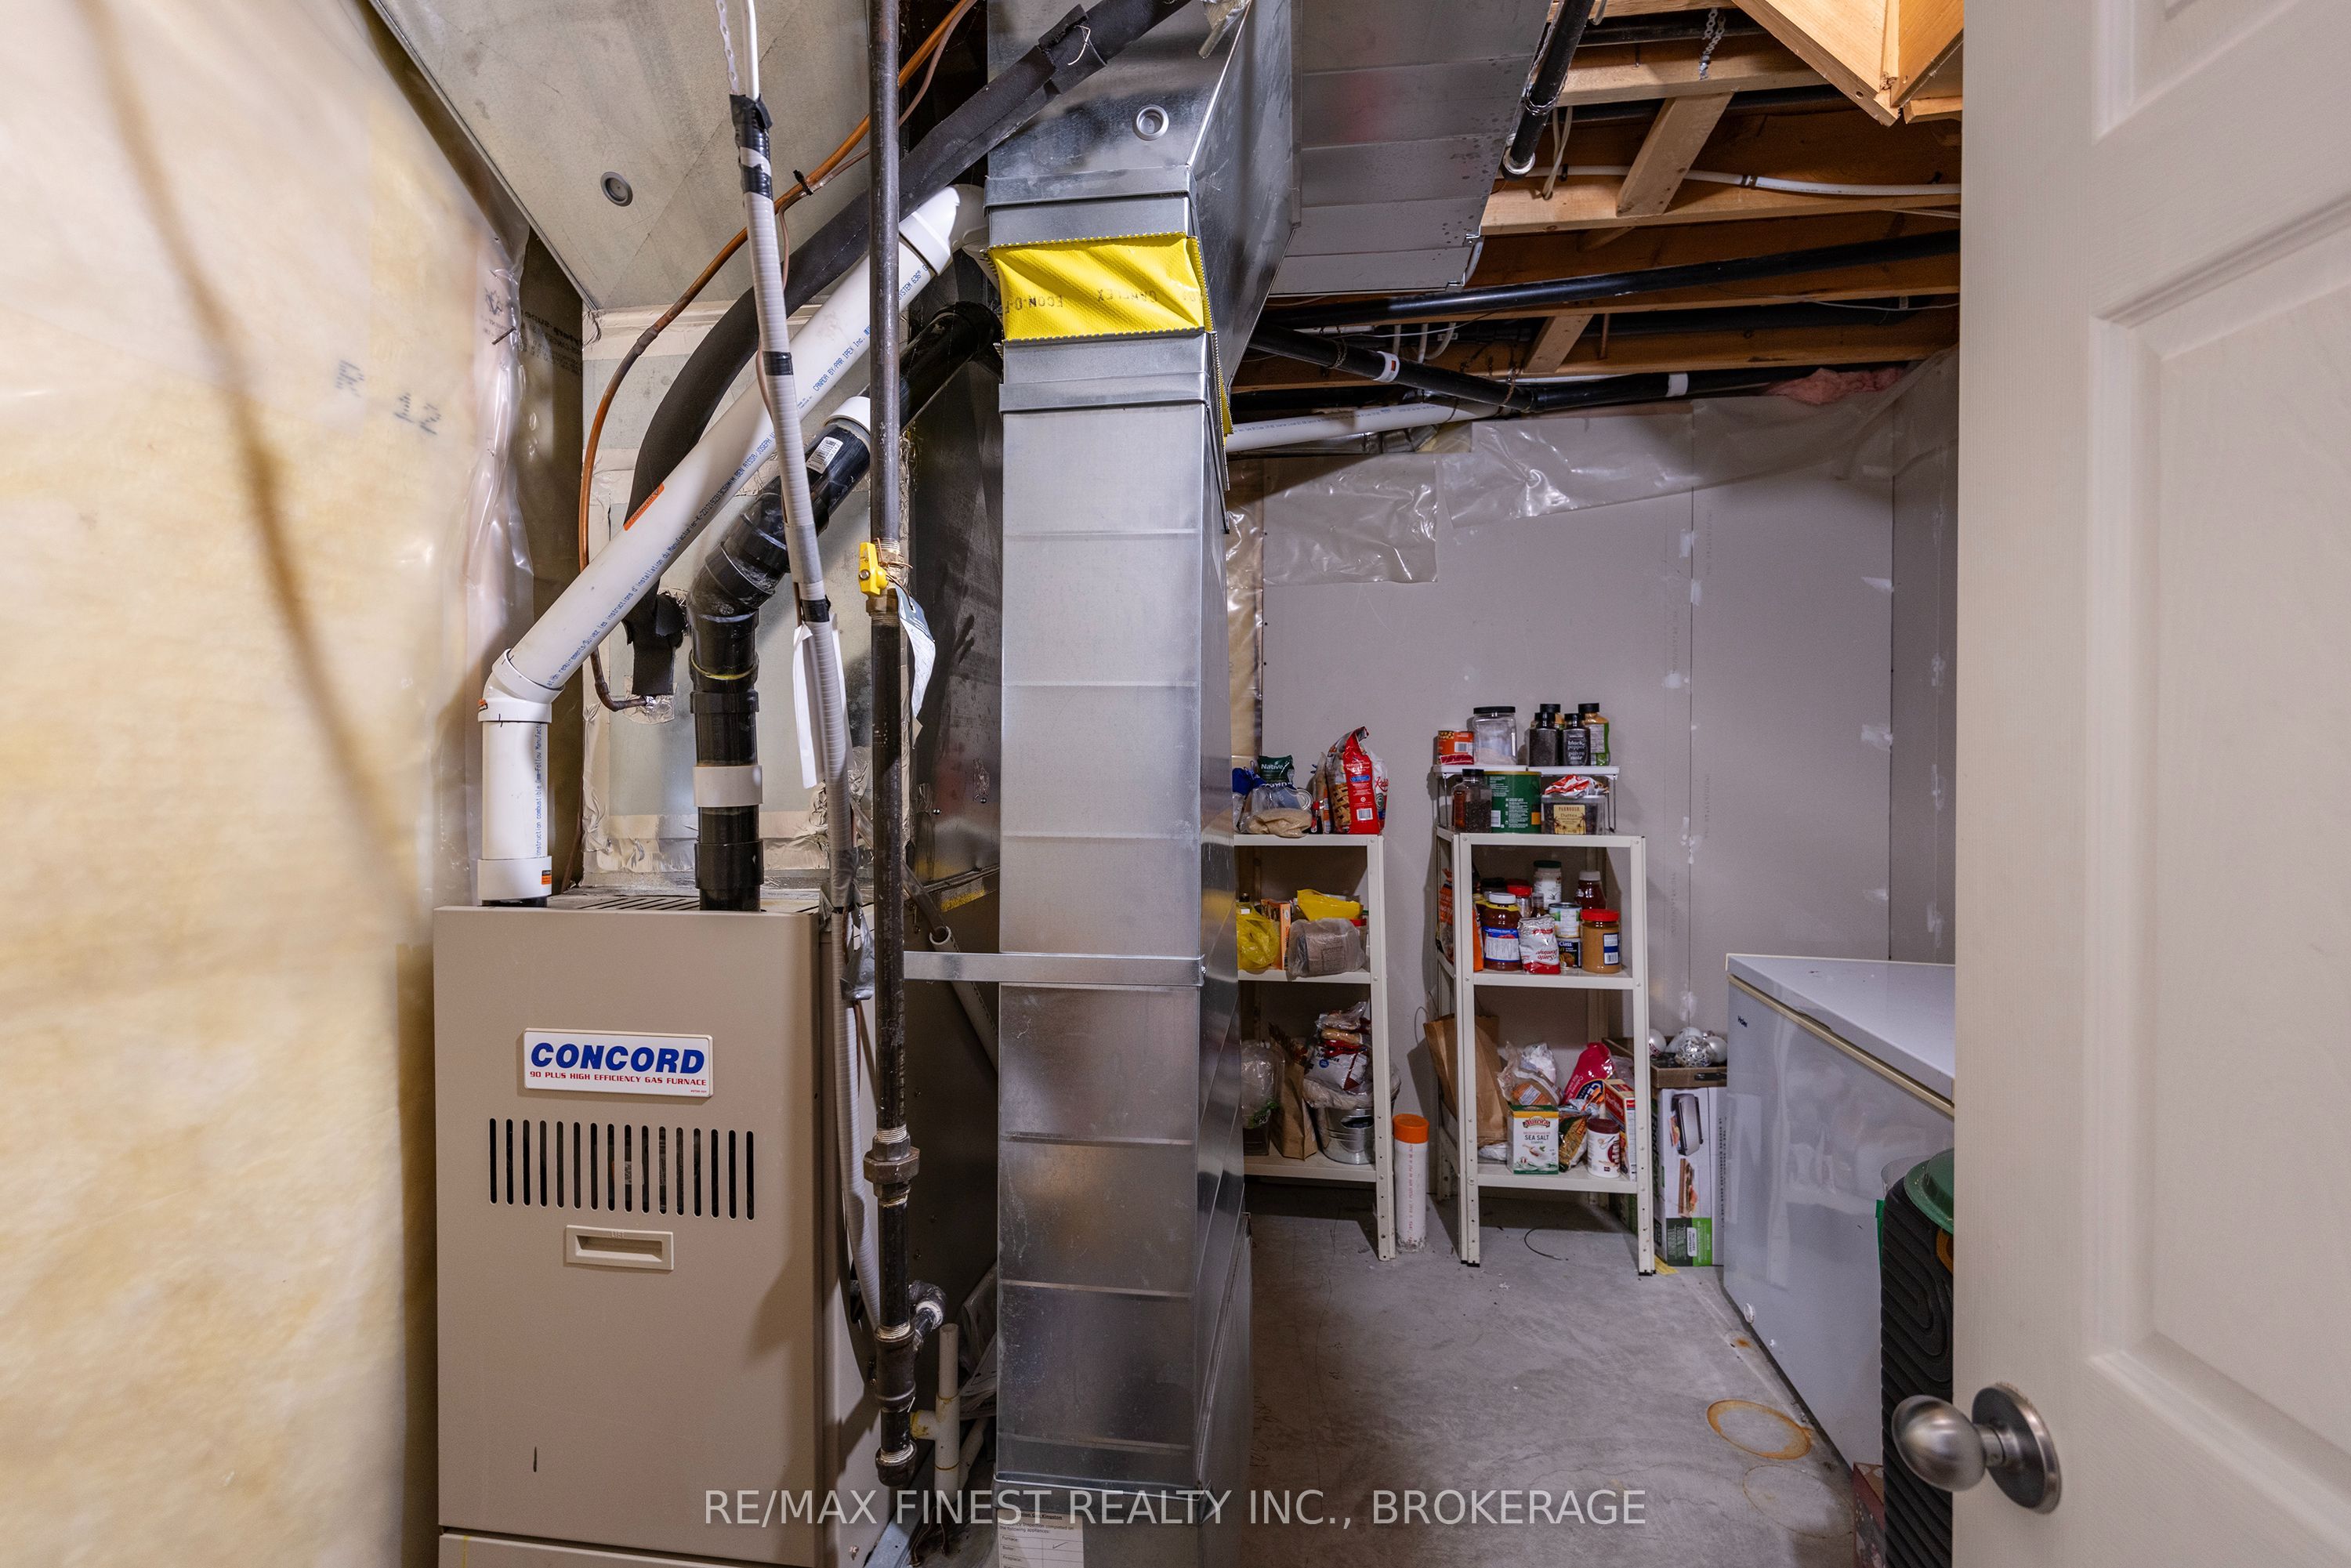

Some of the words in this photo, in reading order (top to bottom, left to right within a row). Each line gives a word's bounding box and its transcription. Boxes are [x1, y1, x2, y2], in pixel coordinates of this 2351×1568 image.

[896, 281, 912, 300] SYSTEM
[335, 359, 364, 398] R
[812, 372, 830, 392] CANADA
[826, 357, 844, 375] BY/PAR
[842, 345, 855, 359] IPEX
[853, 334, 865, 347] Inc.
[531, 1042, 705, 1074] CONCORD
[594, 1074, 641, 1083] EFFICIENCY
[666, 1077, 706, 1086] FURNACE
